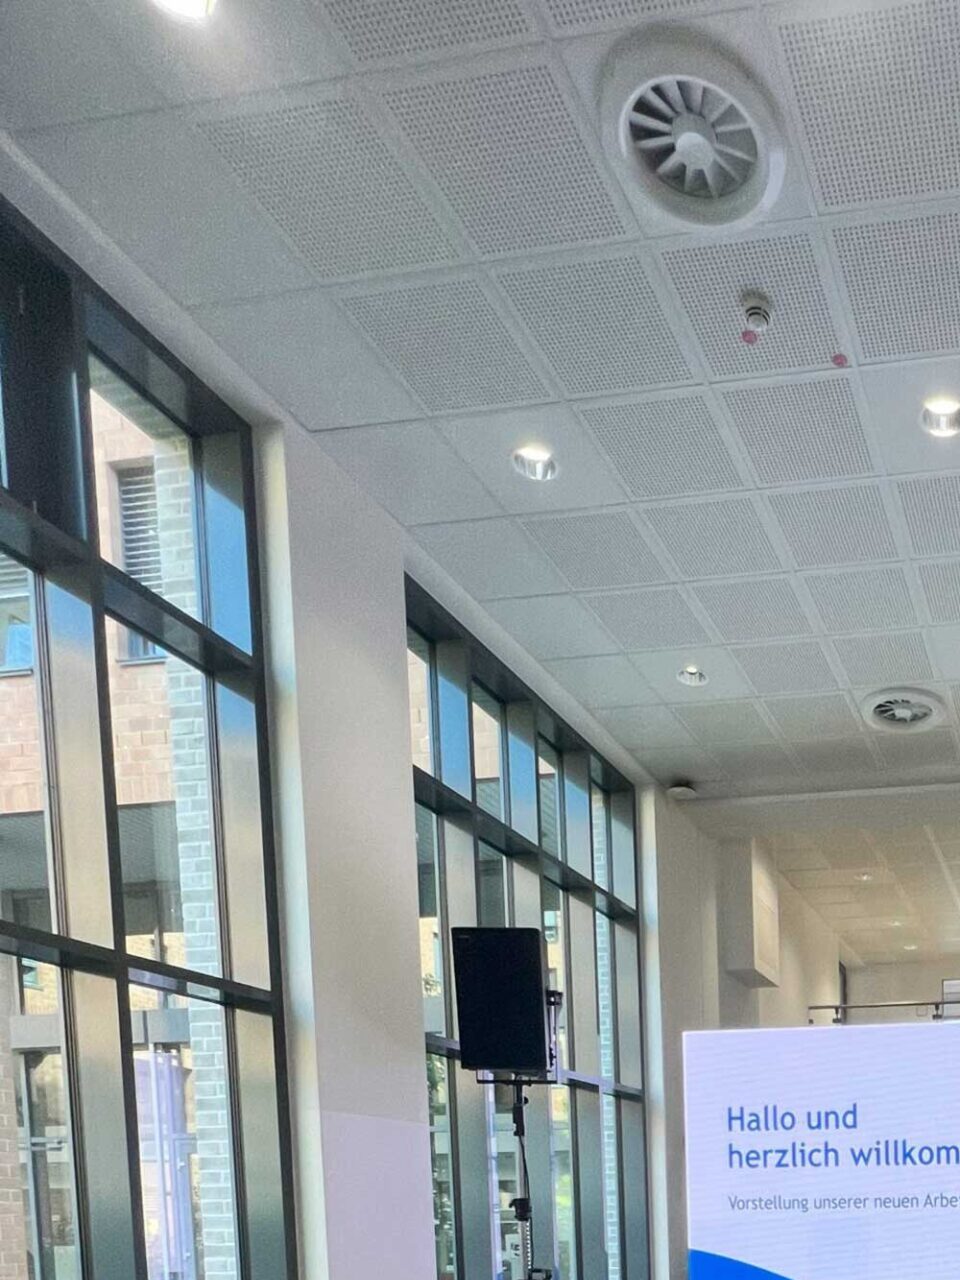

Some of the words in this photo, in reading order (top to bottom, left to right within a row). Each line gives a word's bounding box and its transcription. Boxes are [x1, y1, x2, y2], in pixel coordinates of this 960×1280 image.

[727, 1104, 796, 1132] Hallo
[807, 1102, 857, 1130] und
[728, 1140, 839, 1168] herzlich
[728, 1195, 809, 1212] Vorstellung
[813, 1196, 869, 1210] unserer
[874, 1195, 919, 1209] neuen
